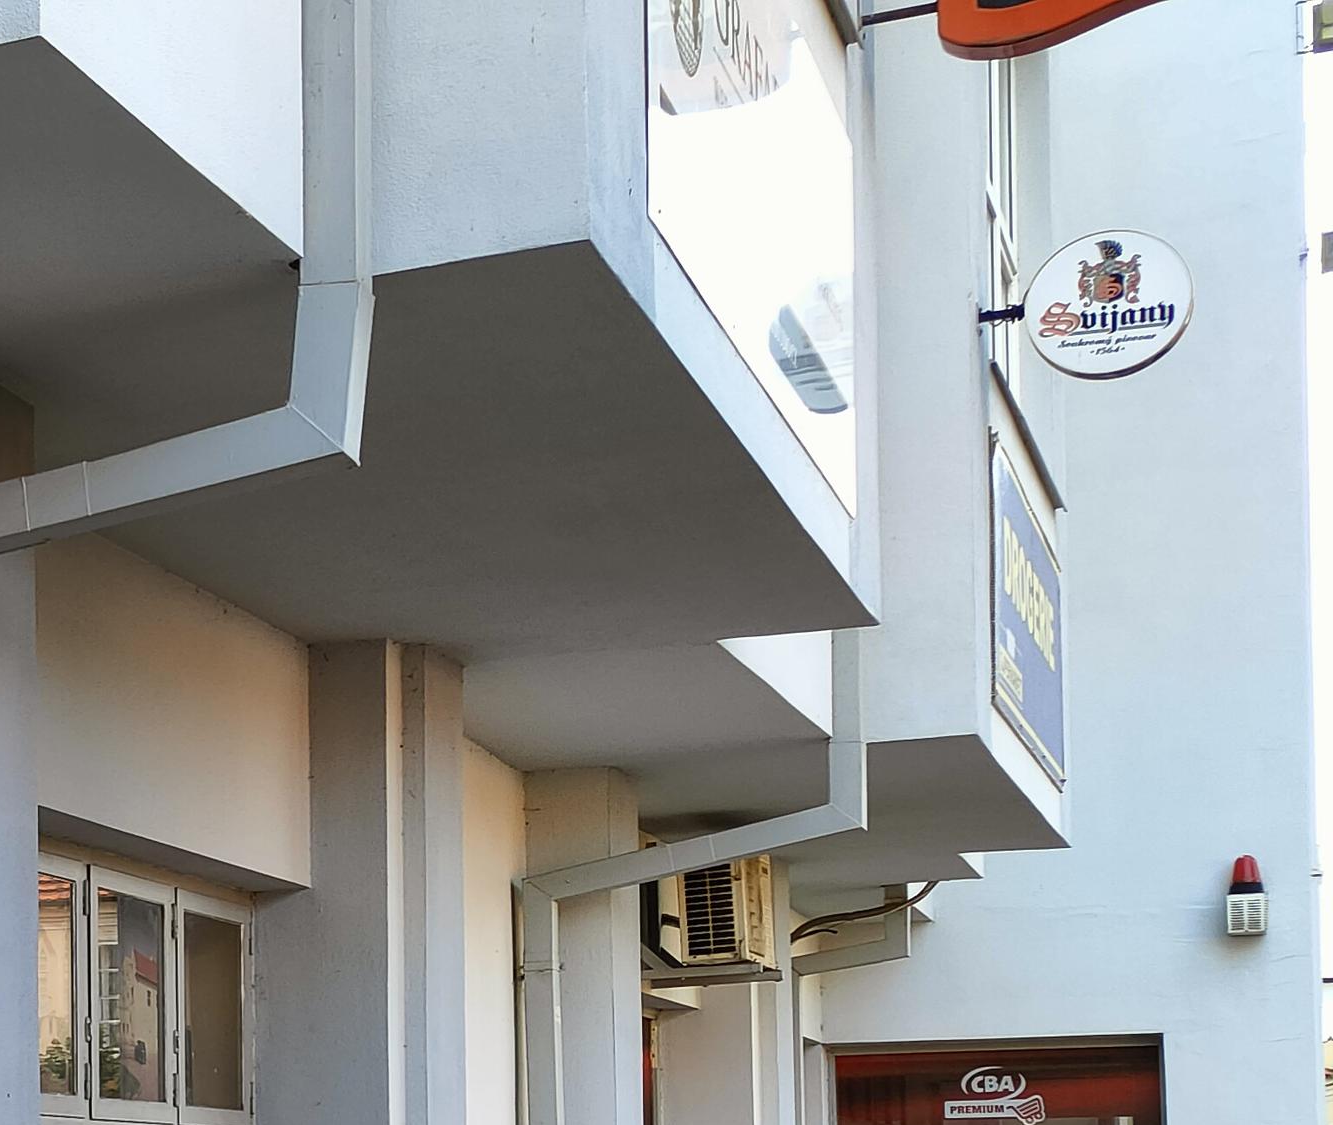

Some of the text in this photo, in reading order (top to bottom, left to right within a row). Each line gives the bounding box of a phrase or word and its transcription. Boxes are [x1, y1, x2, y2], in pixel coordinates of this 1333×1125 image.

[1038, 302, 1175, 338] Svijany
[1003, 515, 1056, 672] DROGERIE
[971, 1075, 1015, 1093] CBA
[950, 1104, 1005, 1114] PREMIUM
